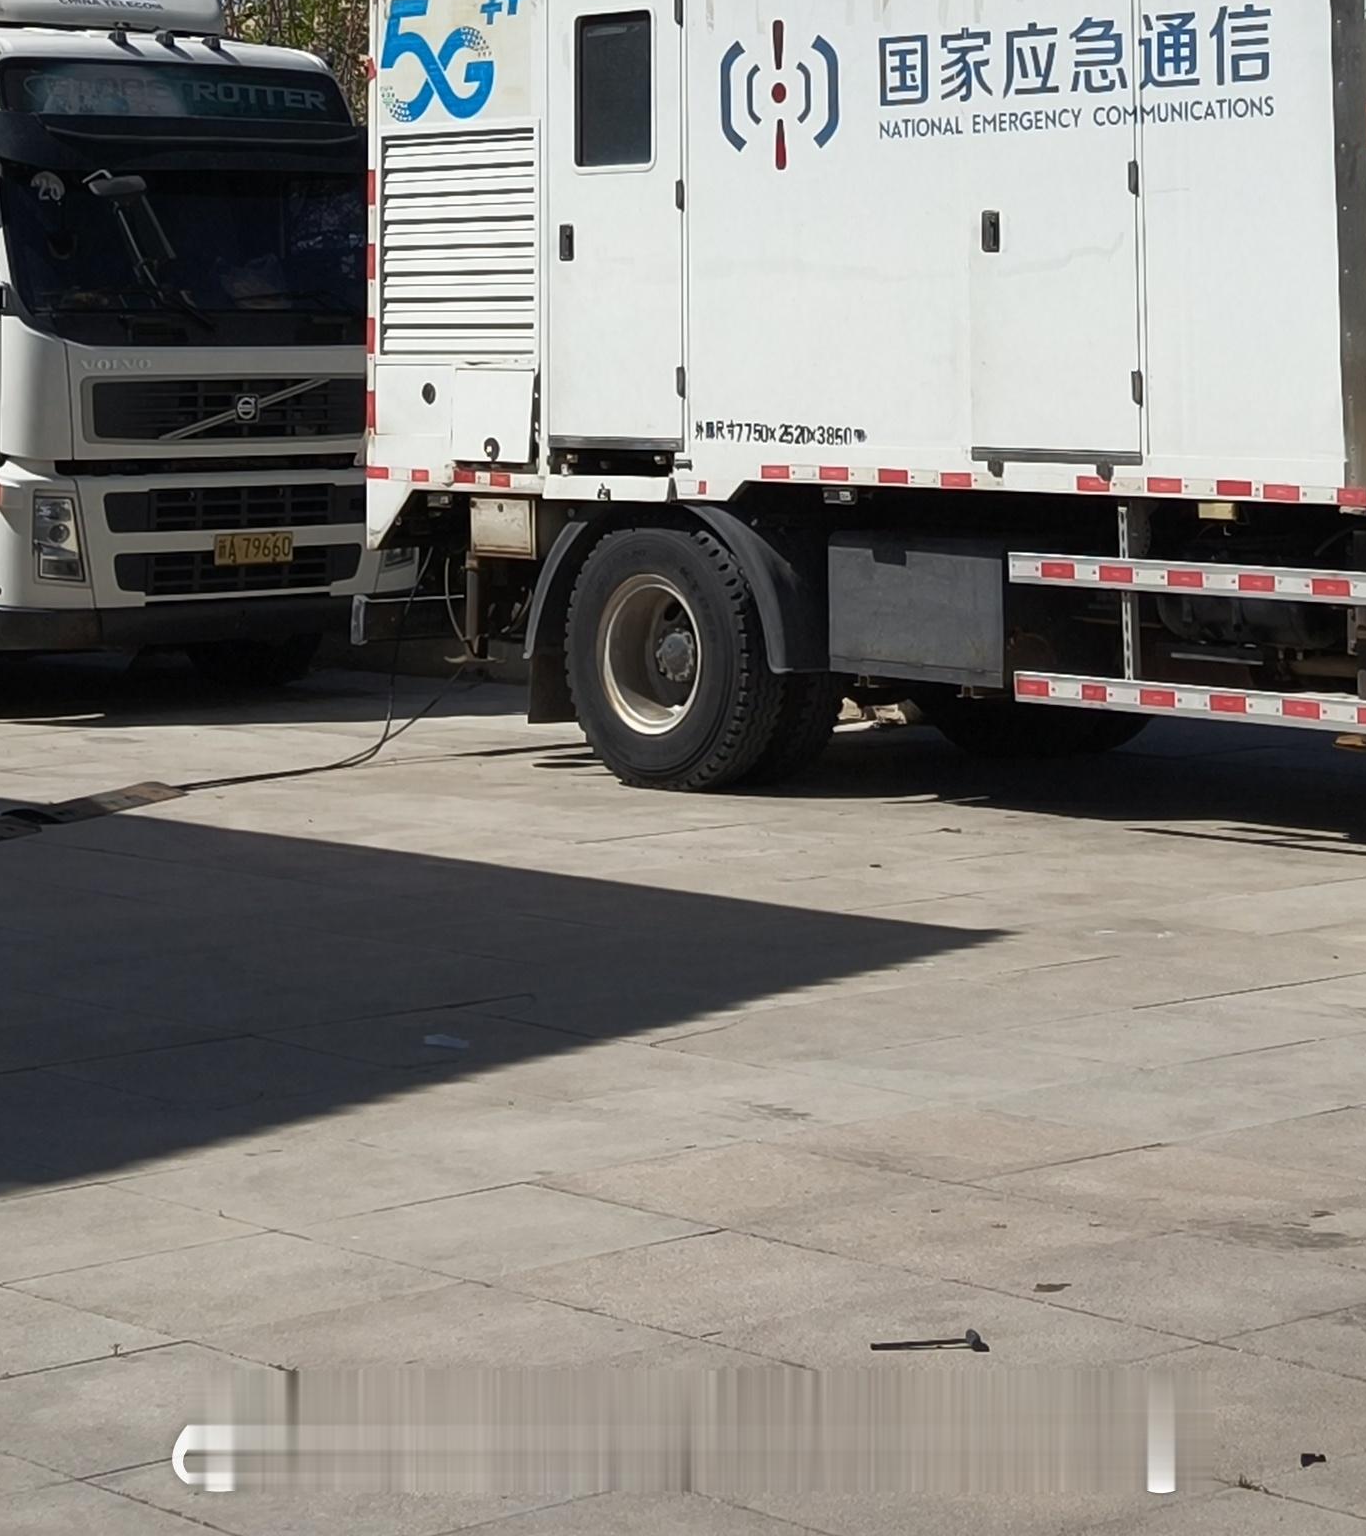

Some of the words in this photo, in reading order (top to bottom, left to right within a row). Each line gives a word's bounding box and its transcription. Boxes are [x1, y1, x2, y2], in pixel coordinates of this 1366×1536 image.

[878, 3, 1273, 107] 国家应急通信
[878, 116, 964, 140] NATIONAL
[972, 107, 1084, 135] EMERGENCY
[1093, 95, 1274, 127] COMMUNICATIONS
